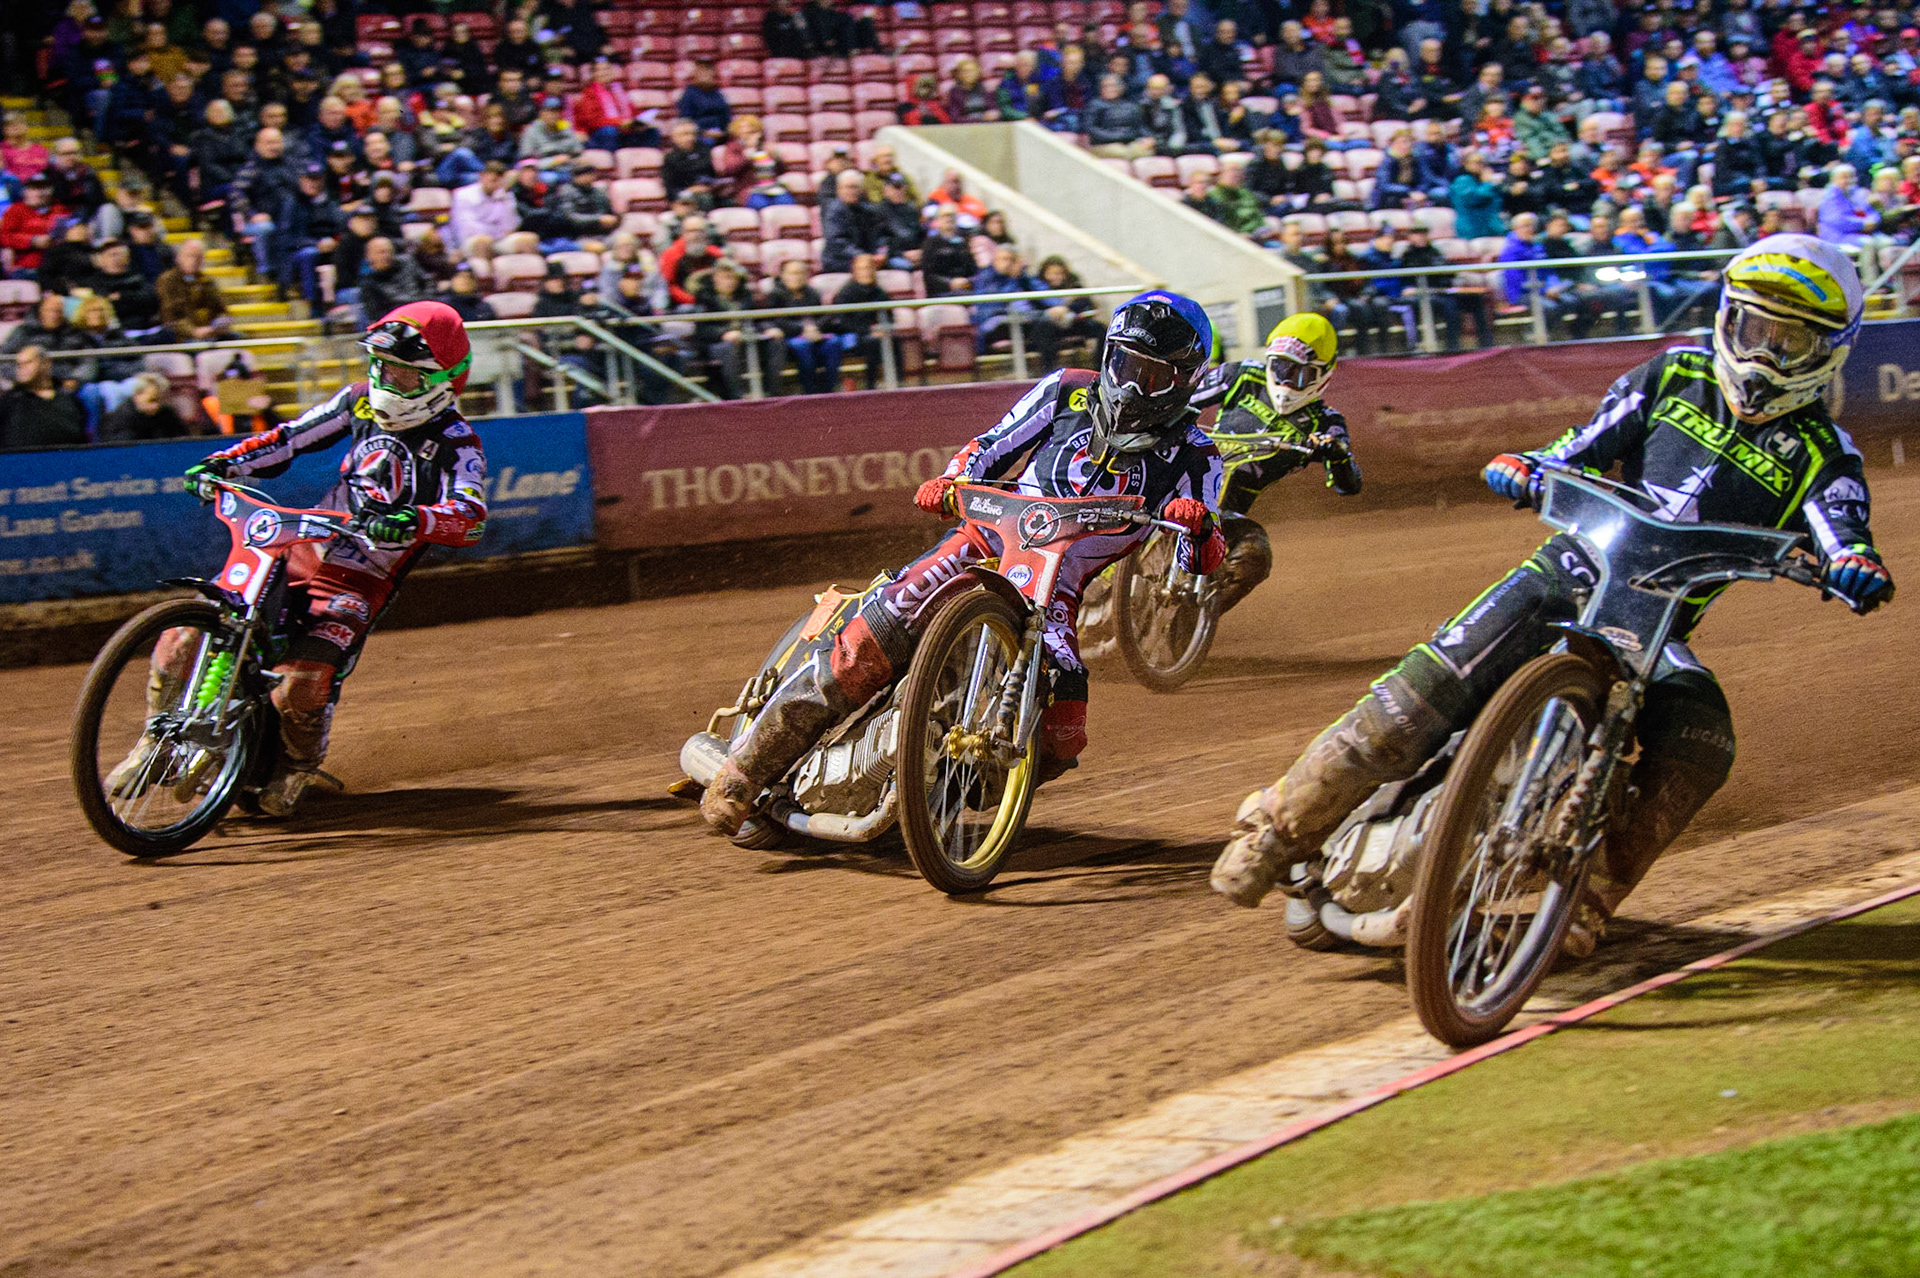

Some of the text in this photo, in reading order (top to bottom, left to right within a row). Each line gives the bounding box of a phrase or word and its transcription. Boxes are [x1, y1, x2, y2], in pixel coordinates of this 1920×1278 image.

[1127, 327, 1155, 344] SHOEI
[420, 441, 437, 459] 4
[1772, 431, 1799, 453] 4
[494, 465, 580, 501] Lane
[640, 445, 962, 510] THORNEYCRO
[1131, 465, 1141, 488] CES
[71, 475, 157, 501] Service
[1009, 571, 1028, 580] ATPI
